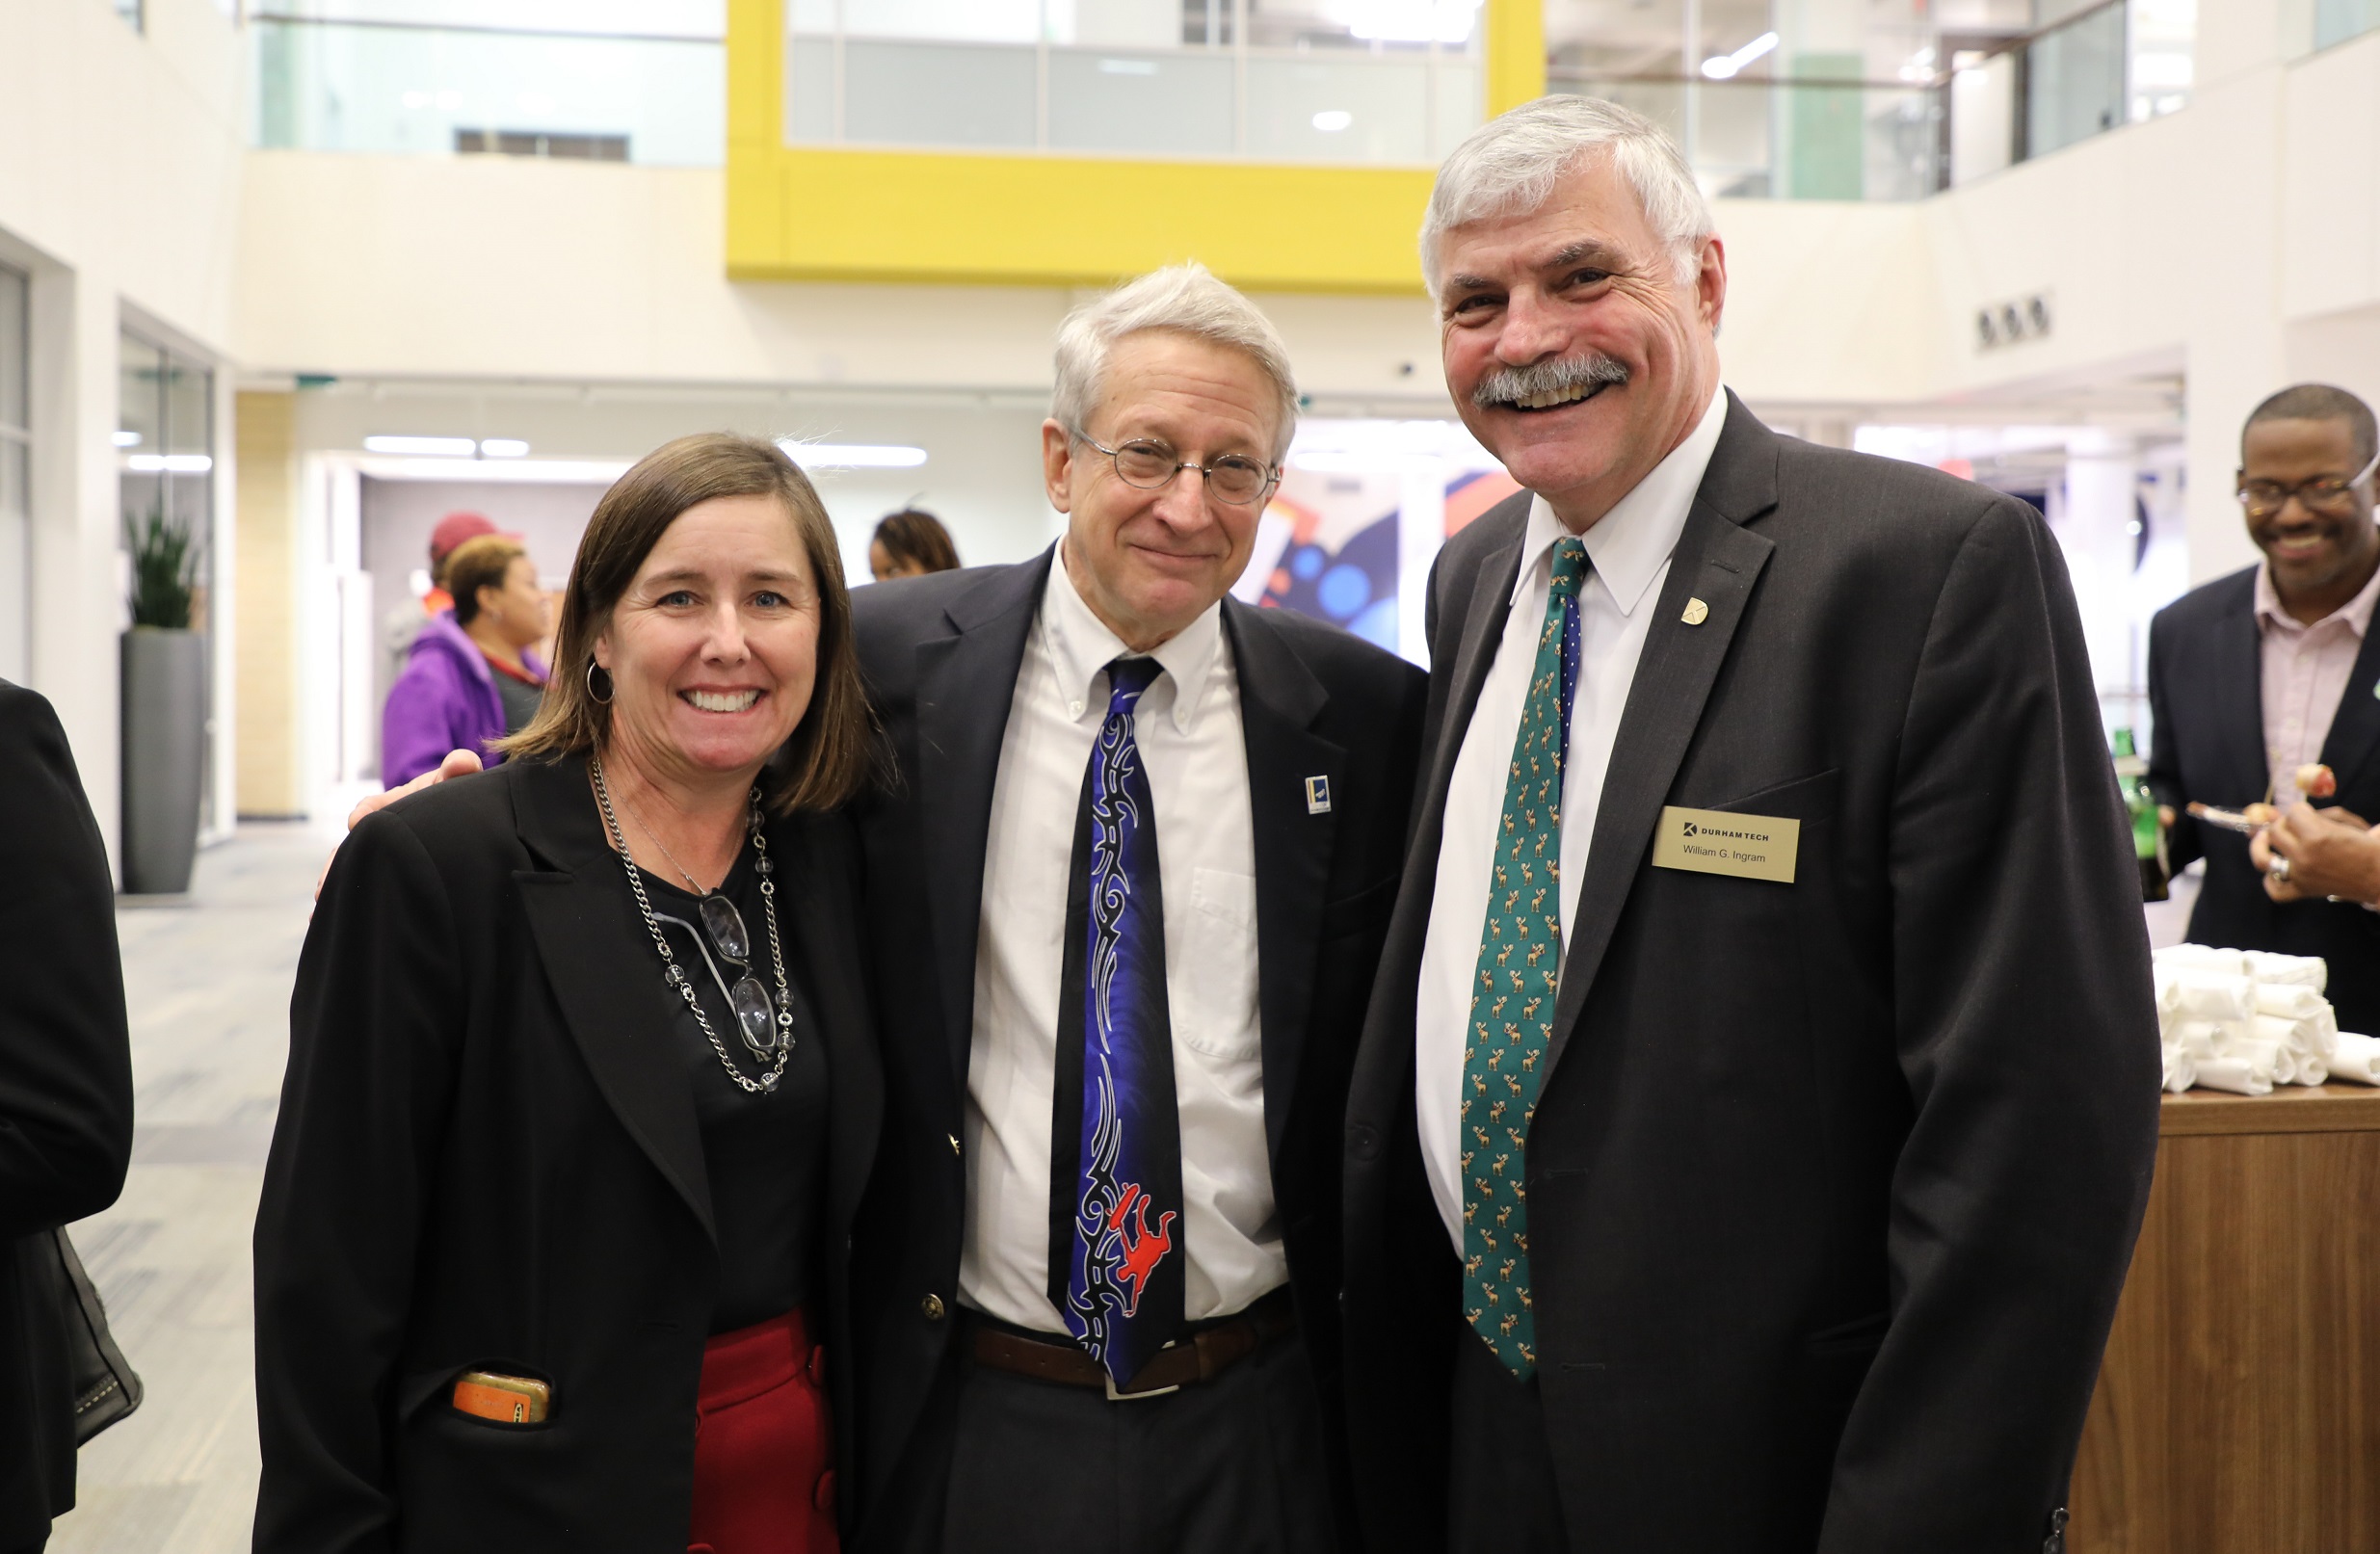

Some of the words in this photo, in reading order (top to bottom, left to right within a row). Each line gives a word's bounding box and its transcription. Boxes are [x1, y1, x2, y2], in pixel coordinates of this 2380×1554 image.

[1702, 828, 1742, 838] DURHAM
[1745, 832, 1769, 841] TECH
[1683, 844, 1716, 856] William
[1719, 849, 1730, 858] G.
[1732, 851, 1765, 862] Ingram
